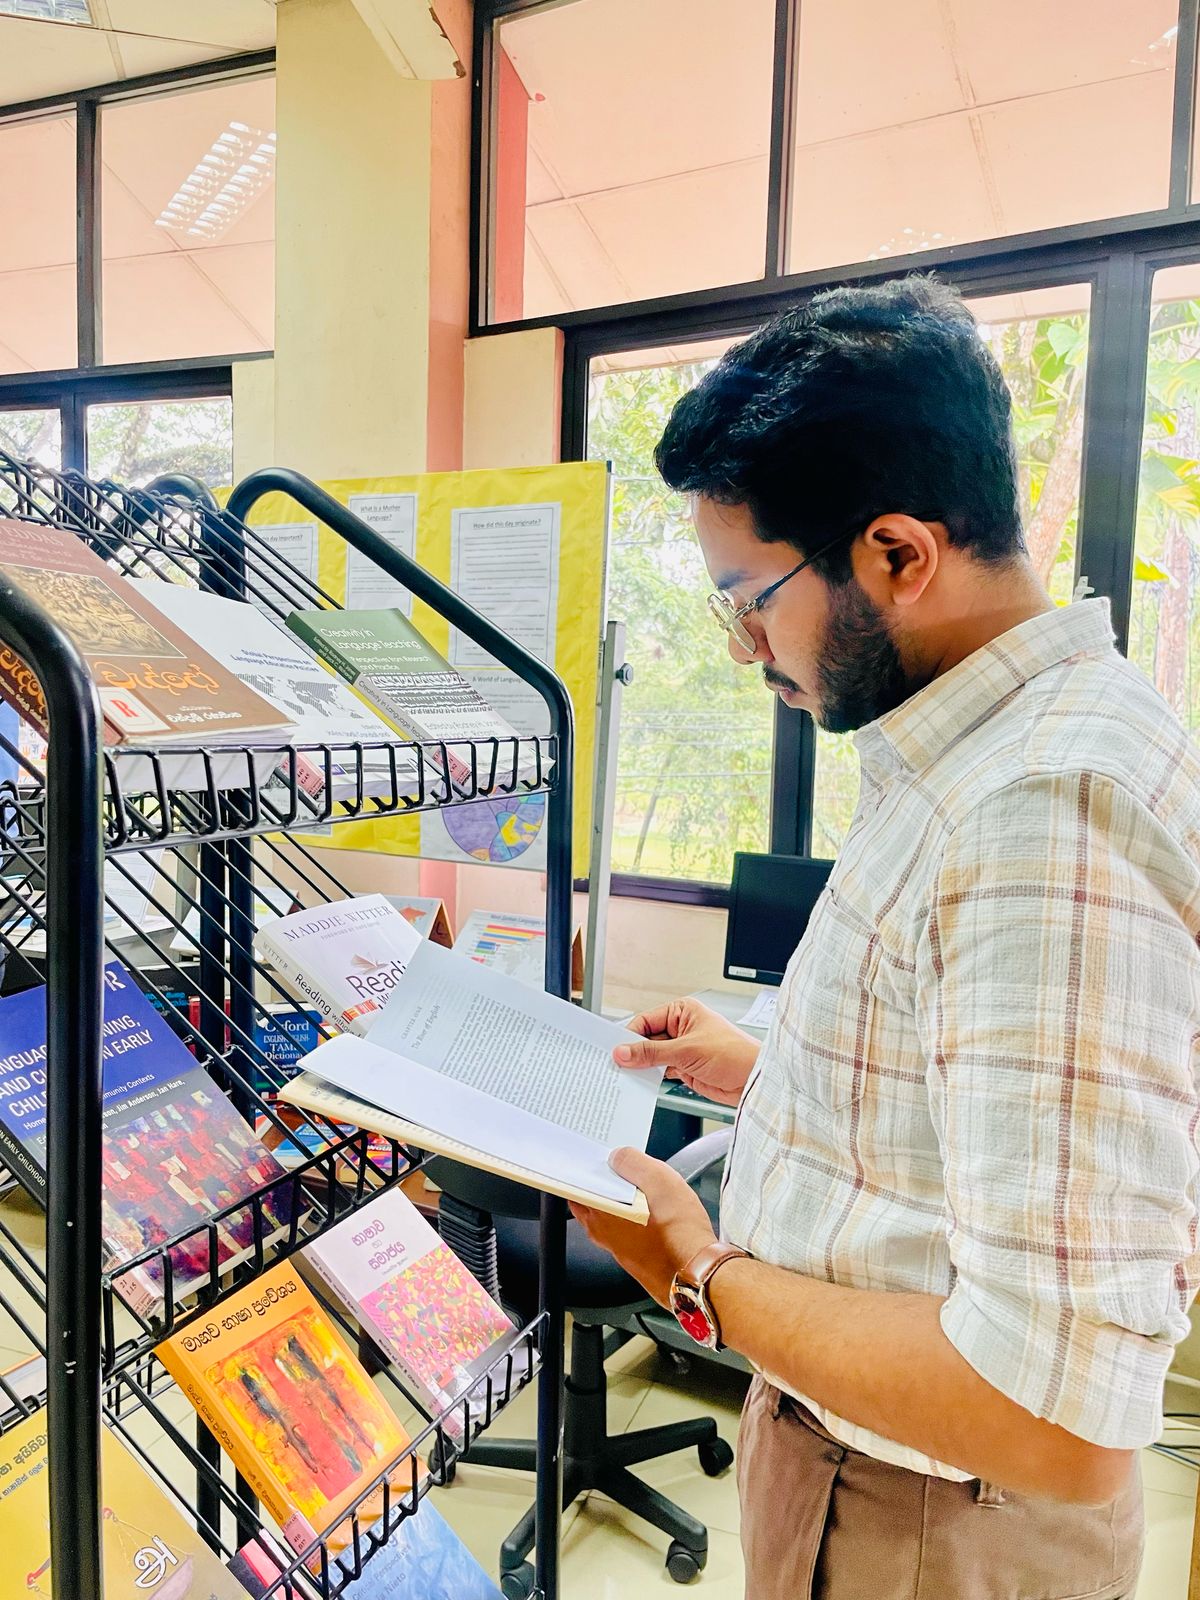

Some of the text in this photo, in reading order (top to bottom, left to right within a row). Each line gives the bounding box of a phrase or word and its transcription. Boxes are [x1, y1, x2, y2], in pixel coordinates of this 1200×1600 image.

[320, 628, 365, 639] Creativity
[335, 640, 421, 651] Language Teaching
[359, 680, 381, 704] Creativity
[386, 706, 412, 732] Language
[283, 905, 394, 941] MADDIE WITTER
[262, 942, 289, 970] WITTER
[345, 960, 406, 999] Readi
[294, 974, 332, 1016] Reading
[265, 1020, 309, 1032] Oford
[111, 1029, 153, 1055] EARLY
[126, 1074, 155, 1088] Contexts
[117, 1103, 128, 1113] Jim
[128, 1094, 157, 1109] Anderson,
[157, 1087, 168, 1098] Jan
[168, 1079, 186, 1092] Hare,
[3, 1134, 20, 1154] EARLY
[17, 1152, 46, 1187] CHILDHOOD
[222, 1307, 252, 1330] භාෂා
[134, 1535, 179, 1589] அ
[384, 1572, 406, 1594] Nieto
